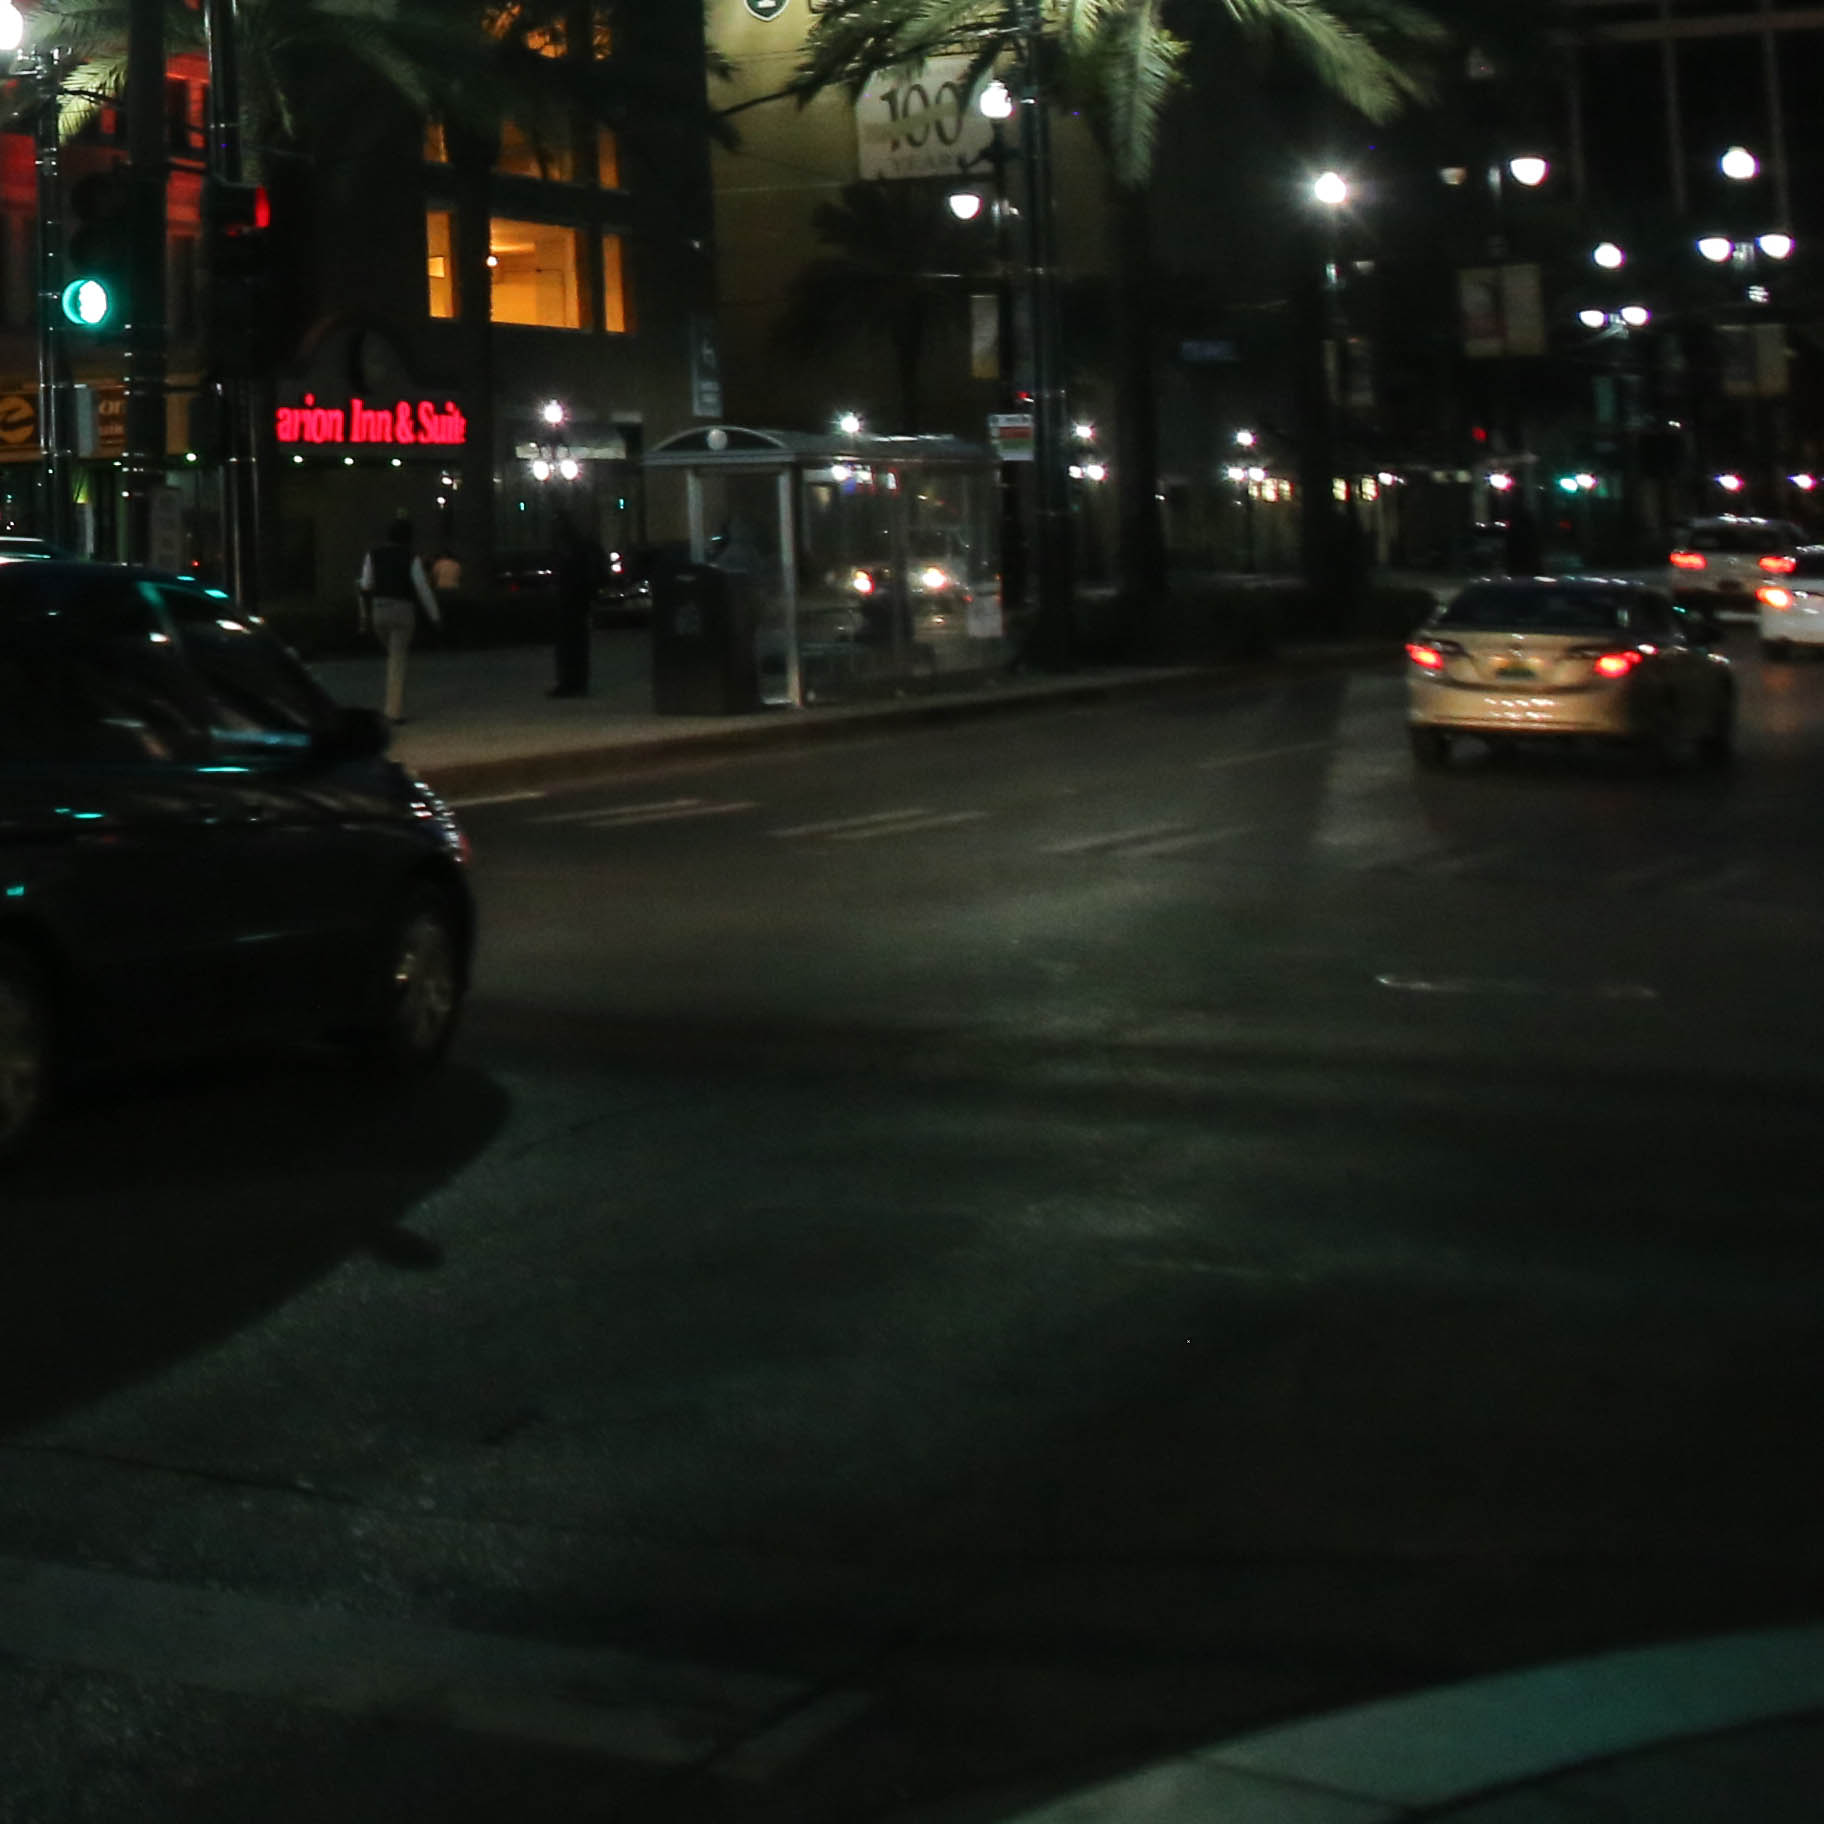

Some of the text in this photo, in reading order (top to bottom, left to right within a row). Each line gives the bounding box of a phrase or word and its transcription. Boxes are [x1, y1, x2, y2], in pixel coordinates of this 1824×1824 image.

[275, 392, 345, 443] arion
[349, 397, 394, 443] Inn
[395, 400, 416, 445] &
